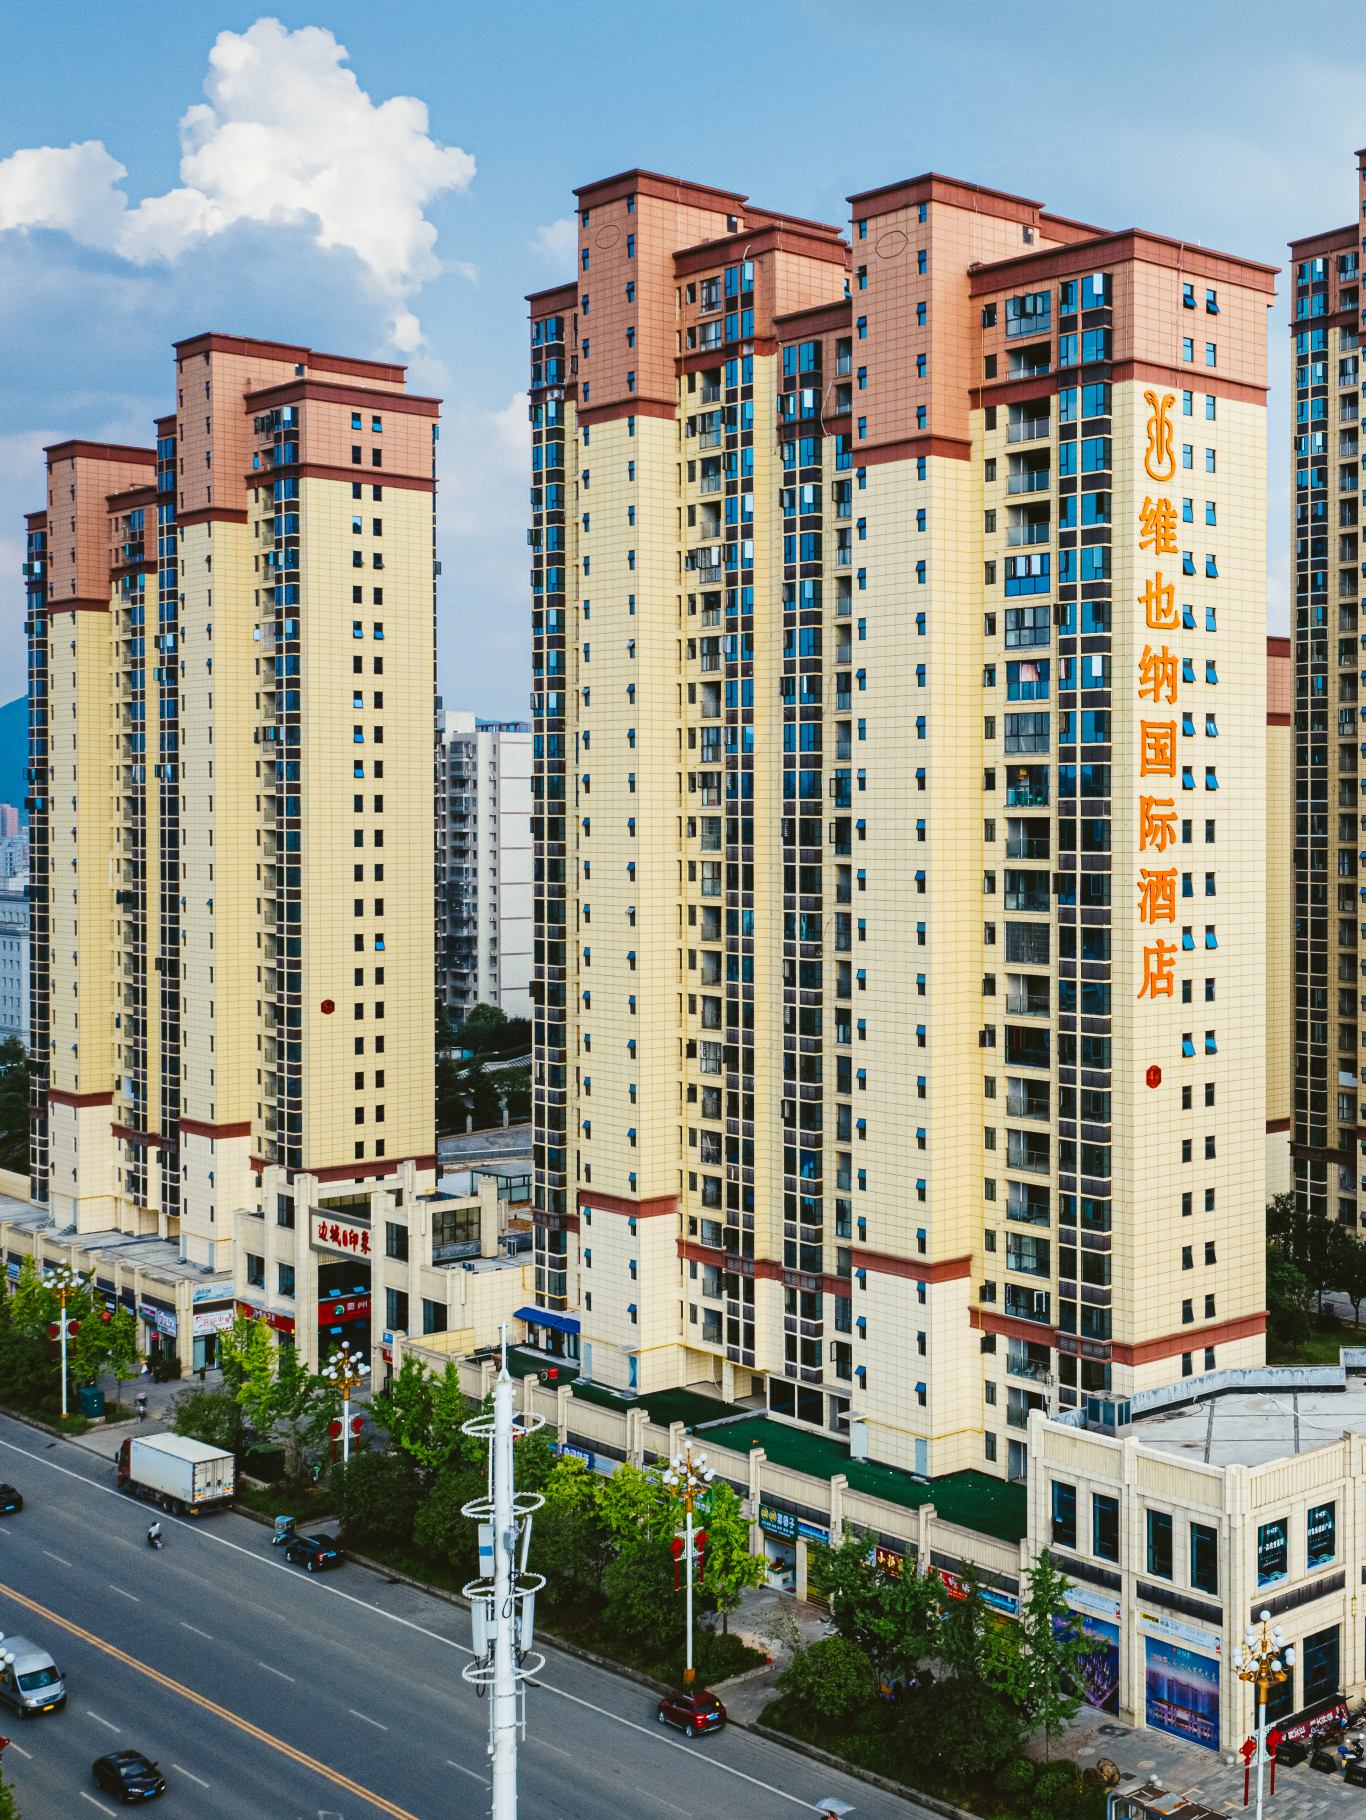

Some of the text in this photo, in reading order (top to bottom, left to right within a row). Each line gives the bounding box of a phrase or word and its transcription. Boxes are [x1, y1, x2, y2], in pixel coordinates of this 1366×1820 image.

[1138, 496, 1180, 1000] 维也纳国际酒店
